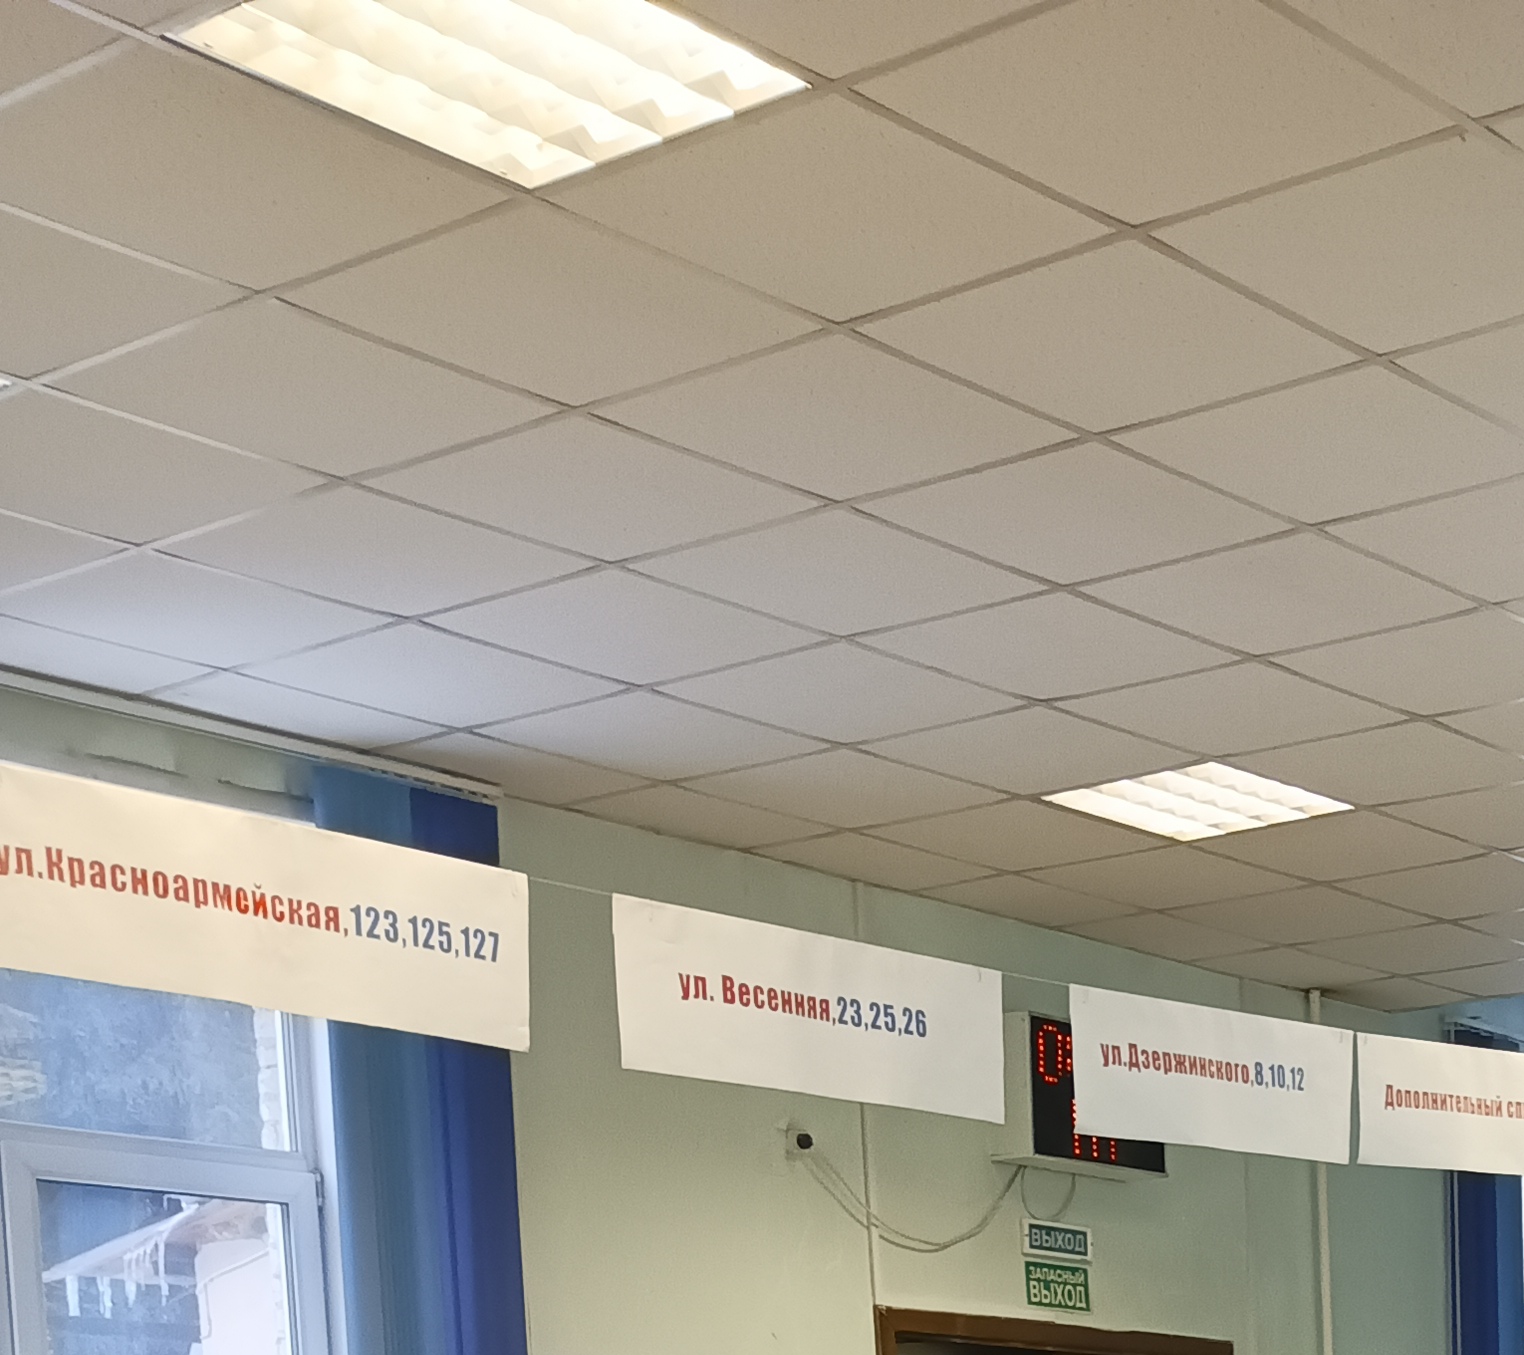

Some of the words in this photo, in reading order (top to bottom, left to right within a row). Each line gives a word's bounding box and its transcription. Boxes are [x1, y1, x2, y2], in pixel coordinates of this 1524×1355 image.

[678, 972, 715, 1002] ул.
[721, 974, 927, 1038] Весенняя,23,25,26
[1100, 1042, 1304, 1092] ул.Дзержинского,8,10,12
[1384, 1084, 1504, 1118] Дополнительный
[1030, 1228, 1085, 1253] ВЫХОД
[1028, 1265, 1085, 1285] ЗАПАСНЫЙ
[1029, 1280, 1087, 1309] ВЫХОД
